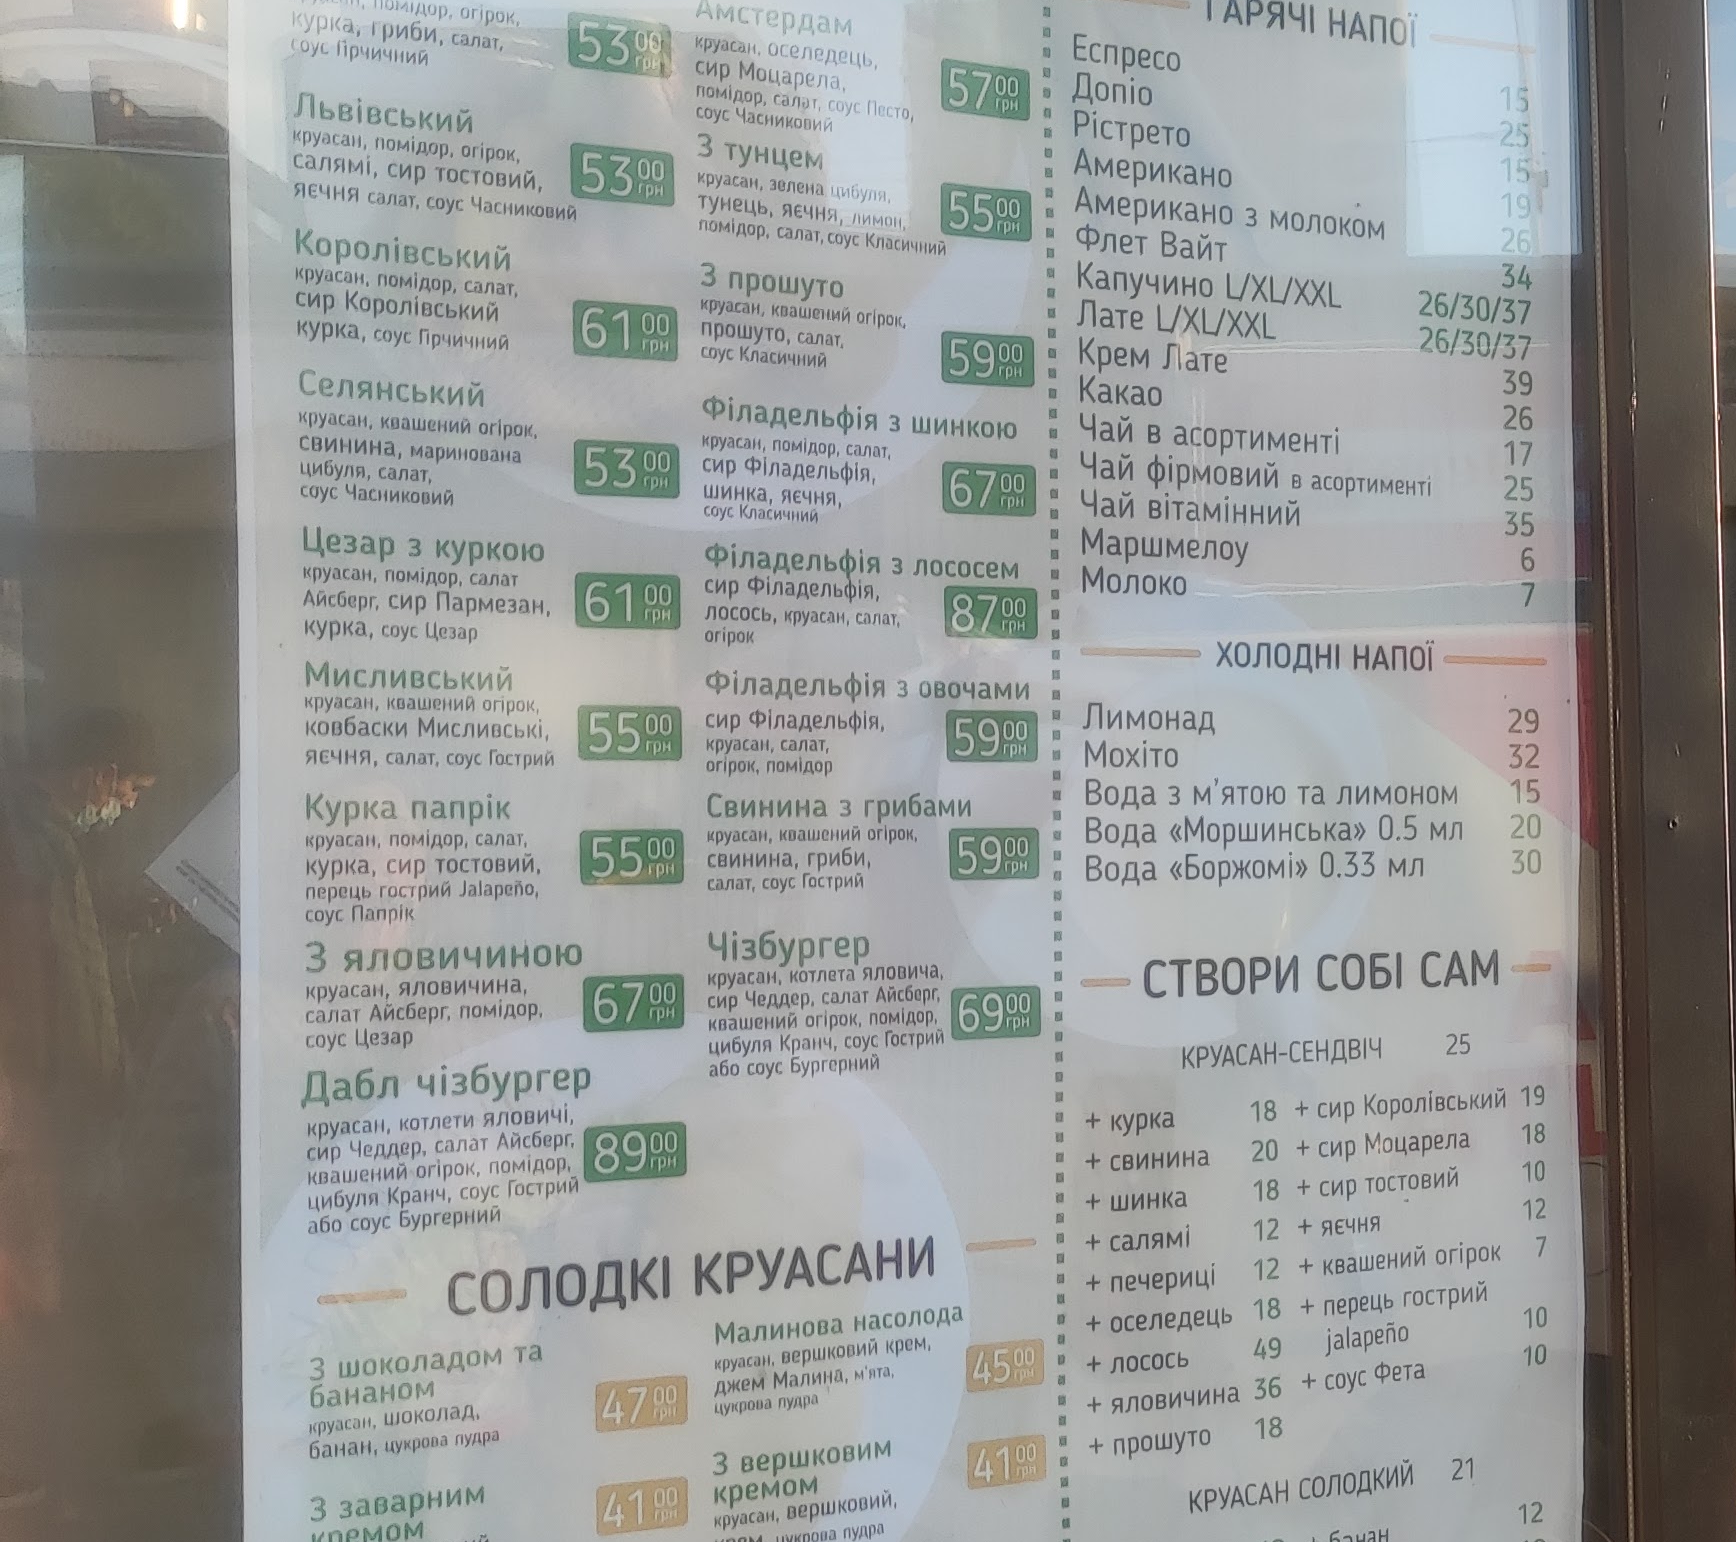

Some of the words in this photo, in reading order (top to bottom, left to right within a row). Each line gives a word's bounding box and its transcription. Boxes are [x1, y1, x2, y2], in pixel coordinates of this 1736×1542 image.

[1328, 6, 1418, 49] НАПОЇ
[1072, 32, 1182, 75] Еспресо
[293, 91, 473, 140] Львівський
[1073, 108, 1191, 151] Рістрето
[697, 132, 714, 158] З
[723, 141, 823, 173] тунцем
[1073, 146, 1233, 189] Американо
[293, 181, 360, 203] яєчня
[425, 196, 464, 216] соус
[470, 195, 578, 223] Часниковий
[295, 227, 511, 272] Королівський
[1075, 223, 1149, 256] Флет
[1160, 230, 1228, 263] Вайт
[700, 261, 717, 288] З
[728, 271, 844, 303] прошуто
[1076, 259, 1214, 300] Капучино
[1226, 272, 1342, 310] L/XL/XXL
[1418, 289, 1532, 326] 26/30/37
[294, 290, 336, 316] сир
[344, 289, 499, 323] Королівський
[1078, 336, 1150, 375] Крем
[1161, 342, 1228, 374] Лате
[1502, 368, 1533, 397] 39
[298, 368, 485, 408] Селянський
[1078, 373, 1163, 407] Какао
[1502, 404, 1534, 432] 26
[302, 525, 396, 564] Цезар
[407, 537, 423, 558] з
[435, 538, 545, 568] куркою
[704, 541, 881, 580] Філадельфія
[891, 556, 903, 576] з
[913, 557, 1020, 581] лососем
[1081, 525, 1250, 569] Маршмелоу
[1520, 546, 1536, 573] 6
[302, 588, 380, 613] Айсберг,
[388, 593, 427, 617] сир
[436, 590, 551, 618] Пармезан,
[1081, 564, 1187, 597] Молоко
[1520, 581, 1536, 608] 7
[304, 660, 513, 692] Мисливський
[1215, 640, 1341, 675] ХОЛОДНІ
[1352, 639, 1435, 673] НАПОЇ
[1081, 700, 1216, 737] Лимонад
[1507, 707, 1540, 734] 29
[766, 755, 833, 778] помідор
[1084, 739, 1179, 769] Мохіто
[1508, 743, 1540, 770] 32
[305, 792, 398, 828] Курка
[410, 793, 511, 827] папрік
[1085, 853, 1159, 887] Вода
[1319, 850, 1376, 879] 0.33
[1388, 857, 1425, 878] мл
[1511, 848, 1542, 875] 30
[305, 885, 372, 905] перець
[379, 880, 451, 902] гострий
[304, 940, 327, 974] З
[343, 939, 583, 973] яловичиною
[707, 929, 870, 969] Чізбургер
[1143, 954, 1300, 1000] СТВОРИ
[1316, 951, 1403, 993] СОБІ
[1419, 948, 1500, 989] САМ
[1181, 1036, 1383, 1070] КРУАСАН-СЕНДВІЧ
[300, 1067, 399, 1110] Дабл
[416, 1062, 591, 1104] чізбургер
[1317, 1100, 1355, 1125] сир
[1363, 1086, 1507, 1122] Королівський
[1520, 1083, 1545, 1107] 19
[1110, 1110, 1176, 1138] курка
[1250, 1099, 1277, 1124] 18
[1319, 1178, 1357, 1203] сир
[1364, 1165, 1459, 1192] тостовий
[1521, 1159, 1546, 1183] 10
[1109, 1223, 1190, 1253] салямі
[1253, 1217, 1280, 1242] 12
[447, 1254, 671, 1320] СОЛОДКІ
[693, 1234, 935, 1297] КРУАСАНИ
[714, 1317, 844, 1346] Малинова
[853, 1305, 964, 1333] насолода
[309, 1356, 325, 1382] З
[338, 1347, 502, 1379] шоколадом
[513, 1343, 543, 1364] та
[309, 1380, 435, 1410] бананом
[1188, 1478, 1290, 1515] КРУАСАН
[1298, 1458, 1414, 1501] СОЛОДКИЙ
[1451, 1456, 1474, 1482] 21
